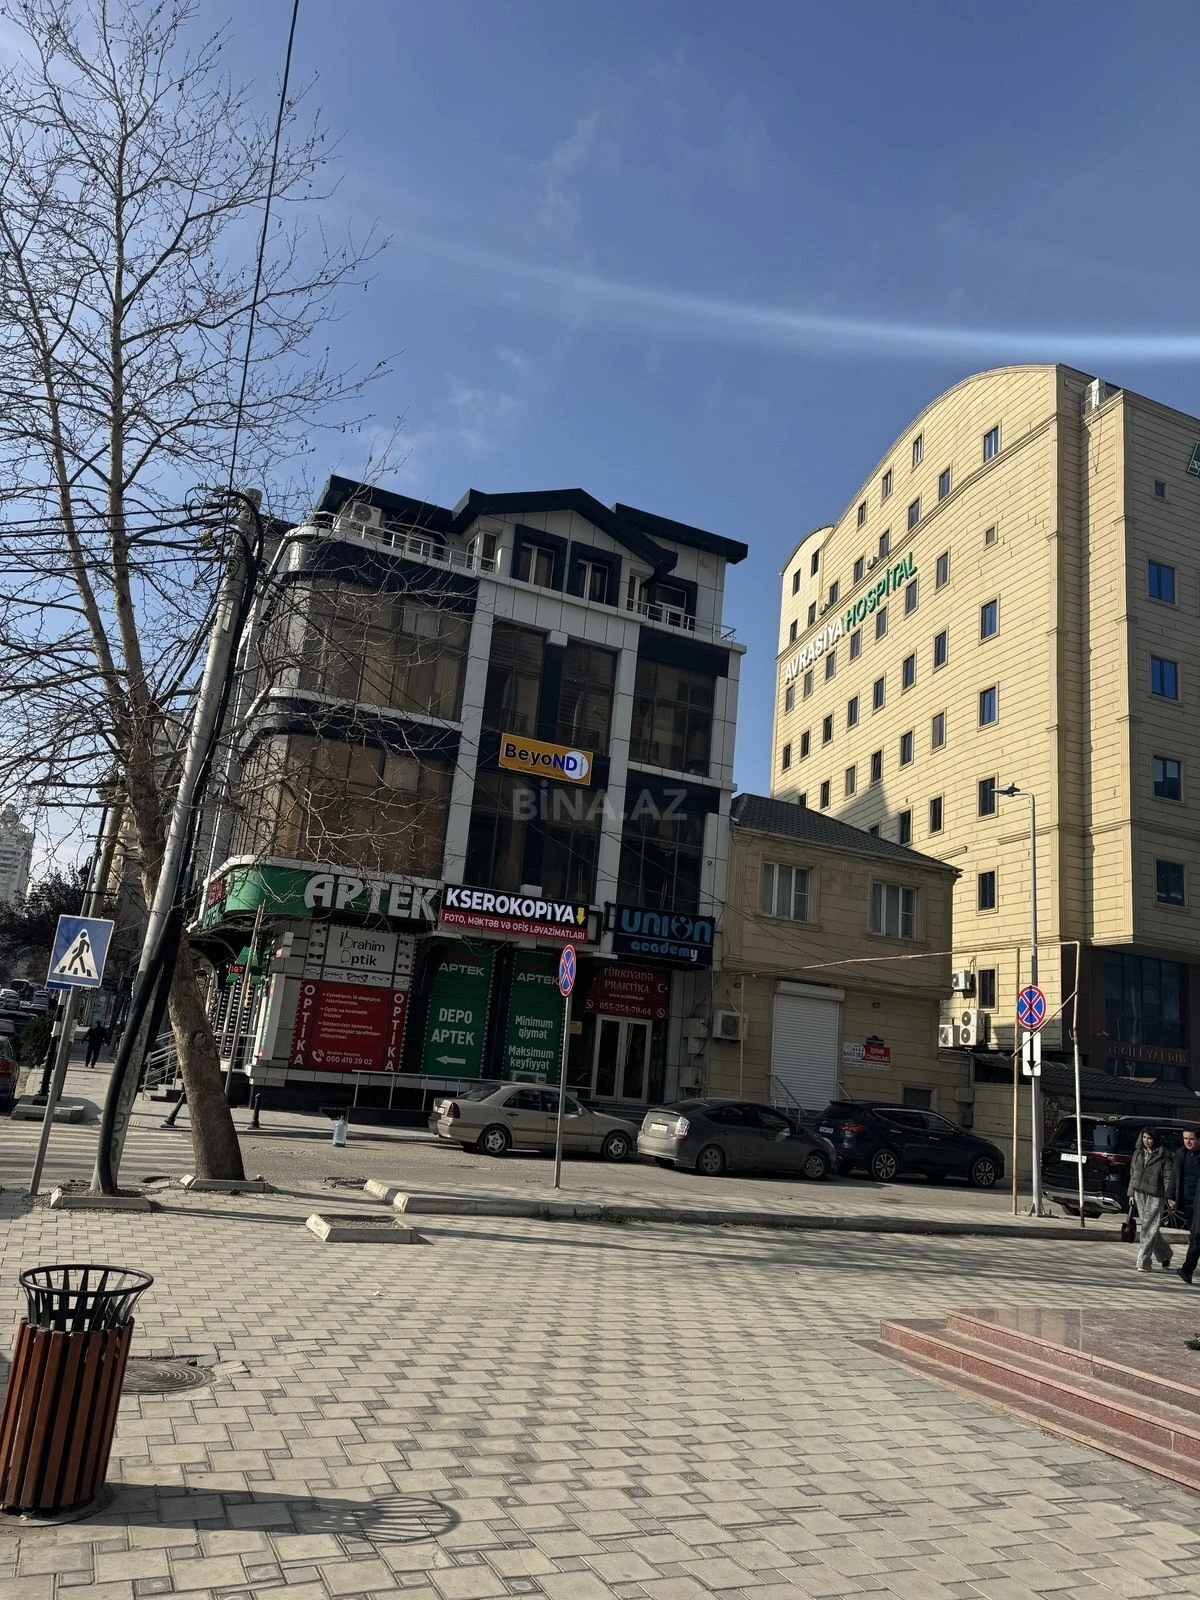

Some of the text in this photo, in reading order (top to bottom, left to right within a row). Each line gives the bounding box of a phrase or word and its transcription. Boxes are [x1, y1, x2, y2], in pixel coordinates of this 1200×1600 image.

[784, 552, 917, 683] AVRASİYA HOSPİTAL
[504, 742, 577, 771] BeyoND
[304, 874, 439, 922] APTEK
[446, 888, 575, 924] KSEROKOPİYA
[444, 913, 585, 940] FOTO, MƏKTƏB VƏ OFİS LƏVAZİMATLARI
[631, 940, 698, 962] academy
[438, 961, 485, 977] APTEK
[517, 971, 559, 985] APTEK
[604, 980, 650, 993] PRAKTİKA
[439, 1007, 472, 1024] DEPO
[515, 1015, 554, 1029] Minimum
[431, 1028, 474, 1046] APTEK
[518, 1025, 547, 1040] qiymət
[508, 1044, 554, 1059] Maksimum
[509, 1056, 550, 1071] keyfiyyət
